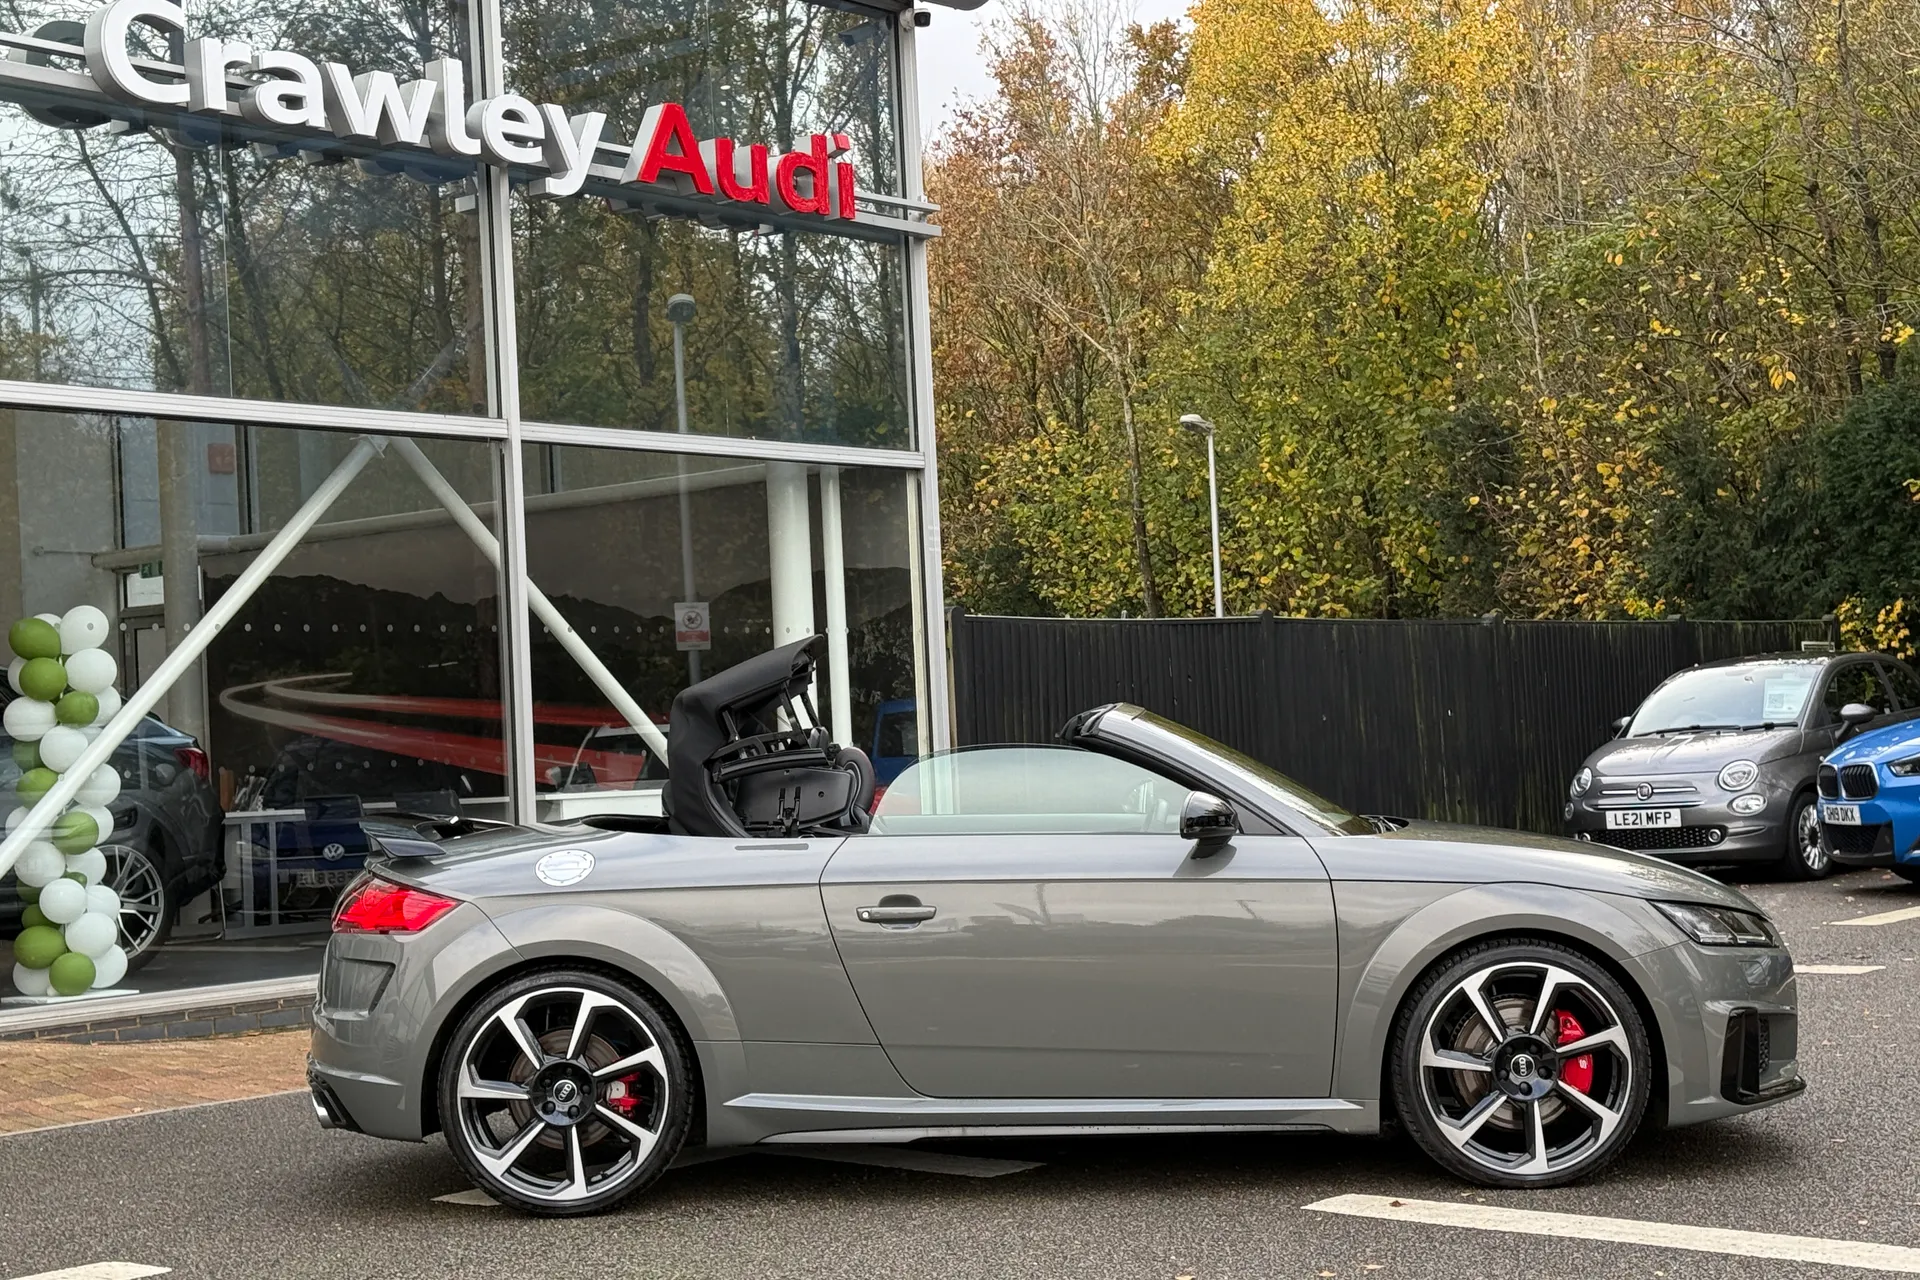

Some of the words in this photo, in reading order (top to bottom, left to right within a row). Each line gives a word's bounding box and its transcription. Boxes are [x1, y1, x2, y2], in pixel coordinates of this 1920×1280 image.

[92, 0, 606, 196] Crawley
[634, 102, 855, 219] Audi
[1613, 812, 1643, 826] LE21
[1645, 811, 1672, 825] MFP
